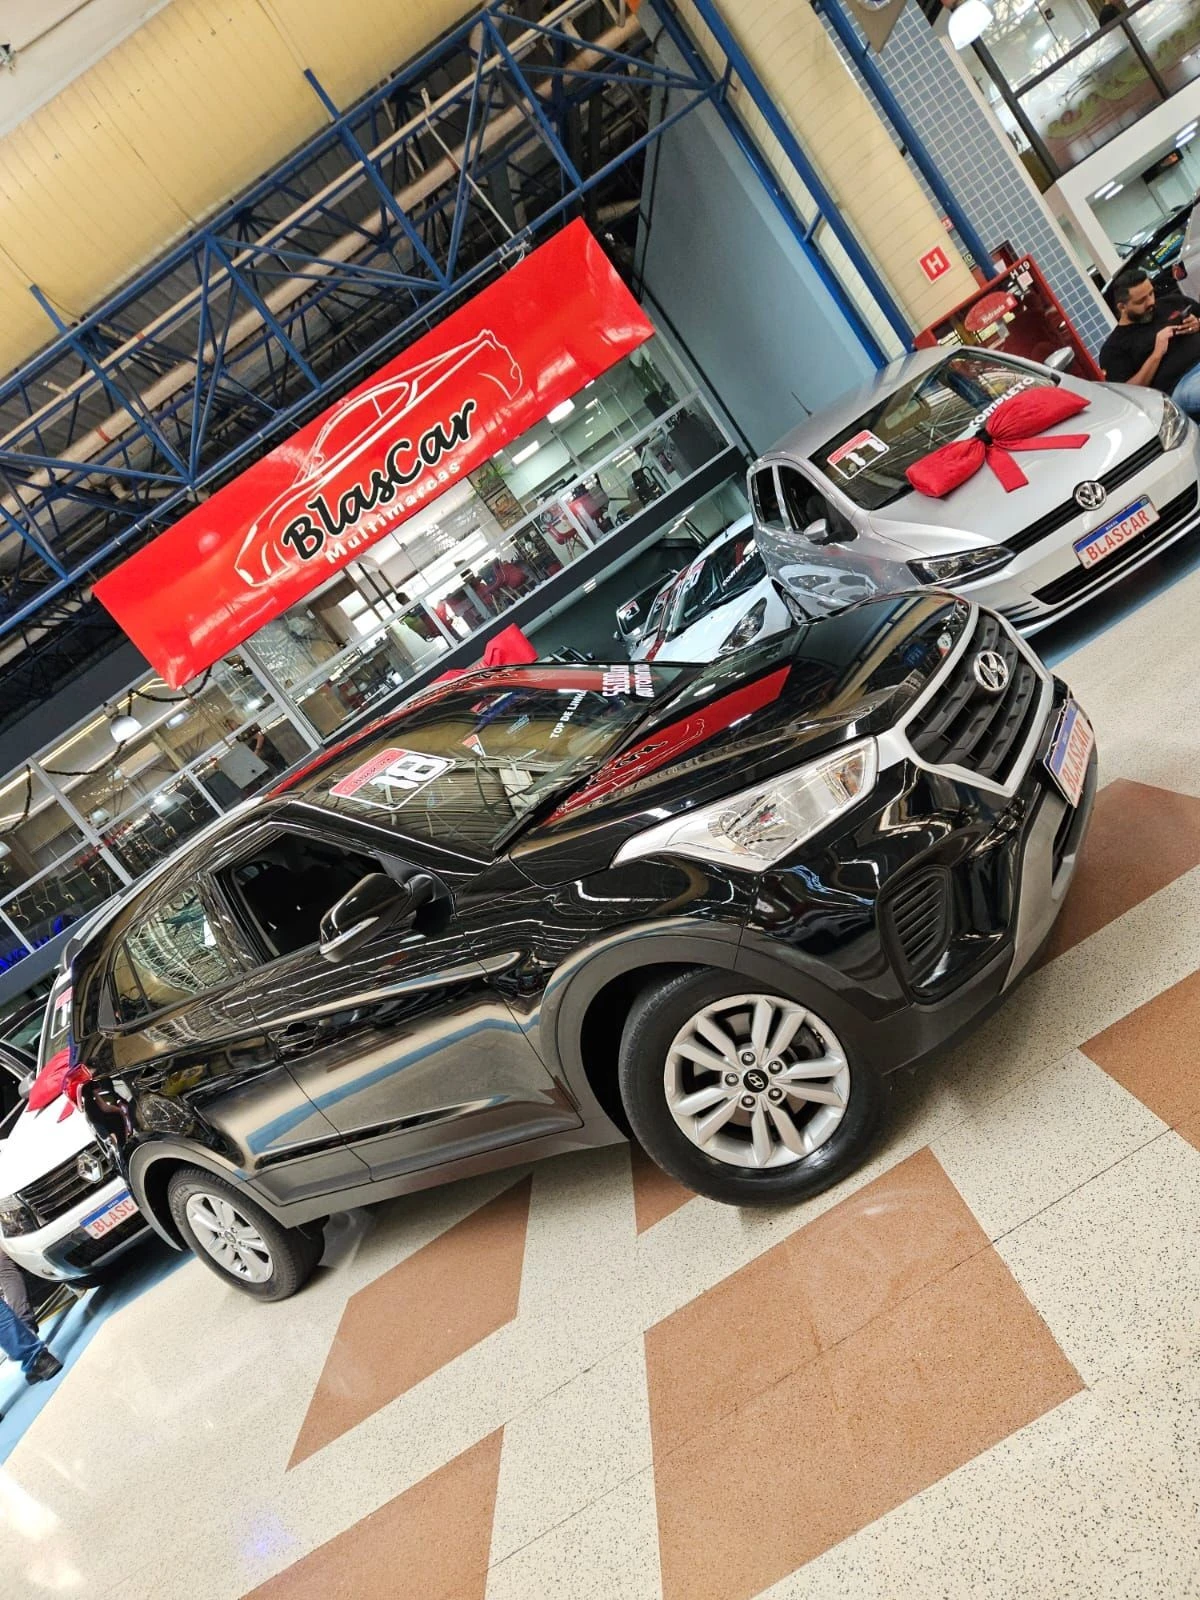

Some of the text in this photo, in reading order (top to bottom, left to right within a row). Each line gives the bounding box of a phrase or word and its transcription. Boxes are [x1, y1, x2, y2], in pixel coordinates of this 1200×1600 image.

[925, 252, 945, 275] H
[1010, 260, 1031, 280] H 19
[281, 398, 477, 561] BlasCar
[324, 462, 461, 564] Multimarcas
[1085, 509, 1150, 561] BLASCAR
[549, 722, 565, 739] TOP
[559, 711, 574, 722] DE
[369, 755, 449, 790] 18
[1062, 718, 1090, 794] BLASCAR
